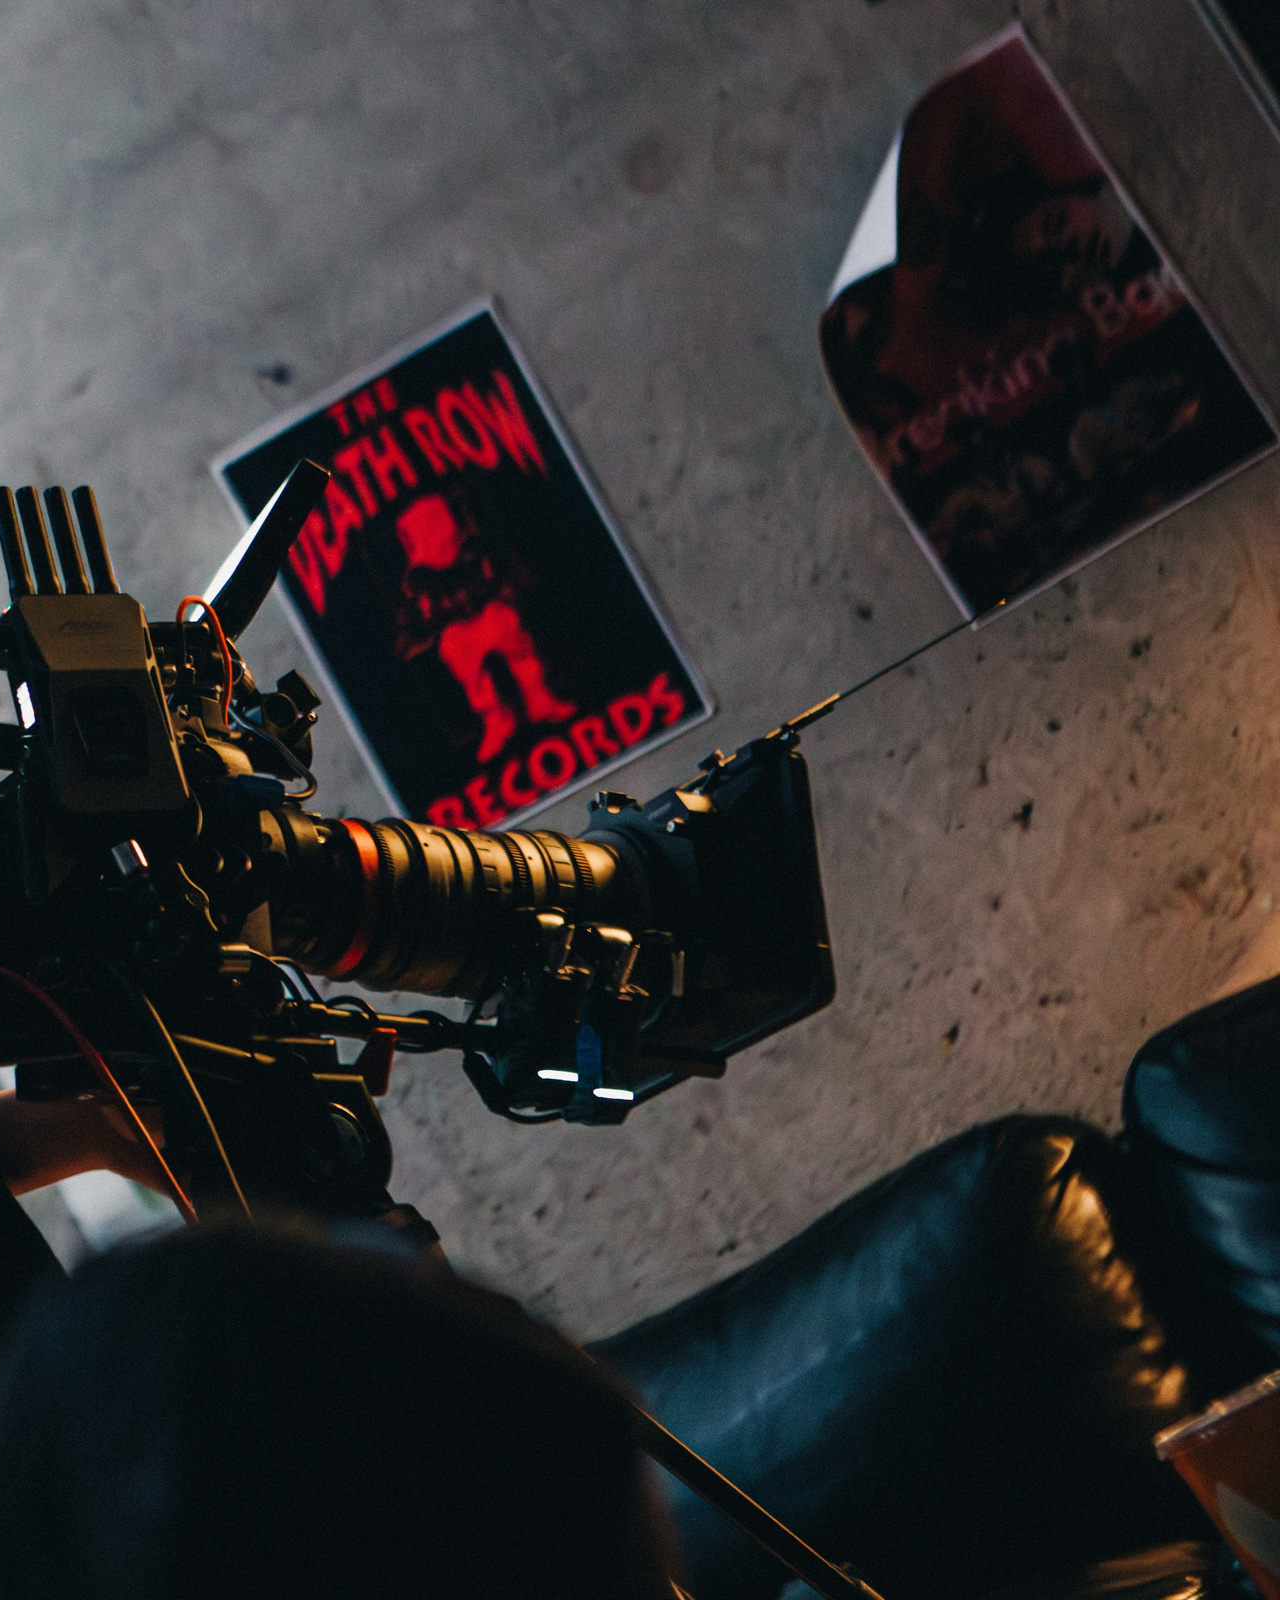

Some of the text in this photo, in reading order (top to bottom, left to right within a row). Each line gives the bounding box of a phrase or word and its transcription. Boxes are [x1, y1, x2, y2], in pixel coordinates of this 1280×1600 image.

[327, 376, 398, 435] THE
[403, 369, 546, 476] ROW
[426, 672, 684, 830] RECORDS
